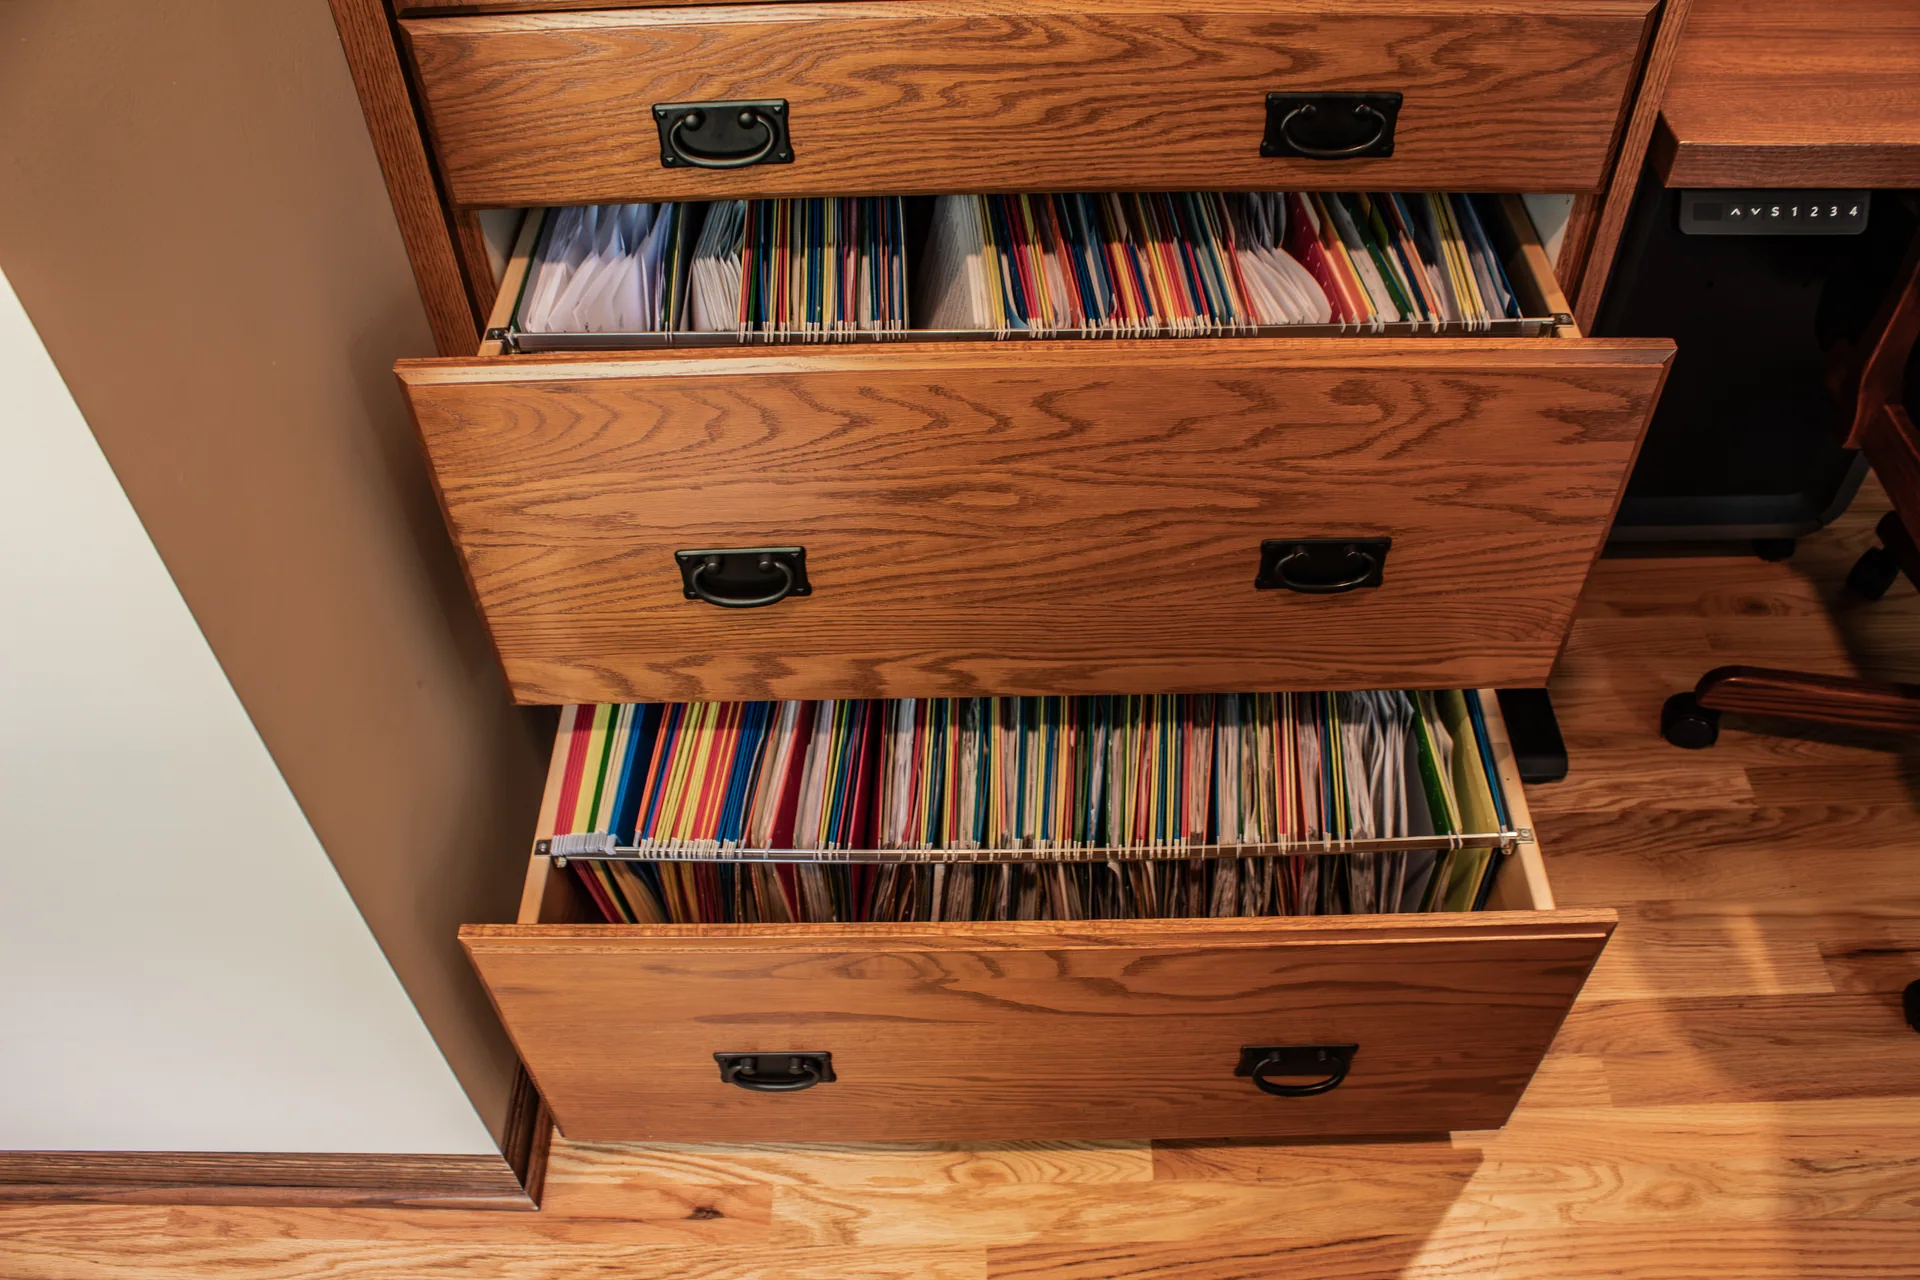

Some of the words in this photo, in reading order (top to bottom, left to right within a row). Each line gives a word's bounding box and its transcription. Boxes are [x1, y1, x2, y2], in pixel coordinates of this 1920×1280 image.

[1770, 206, 1780, 217] S
[1791, 206, 1798, 217] 1
[1810, 206, 1819, 217] 2
[1829, 206, 1838, 217] 3
[1848, 205, 1858, 217] 4
